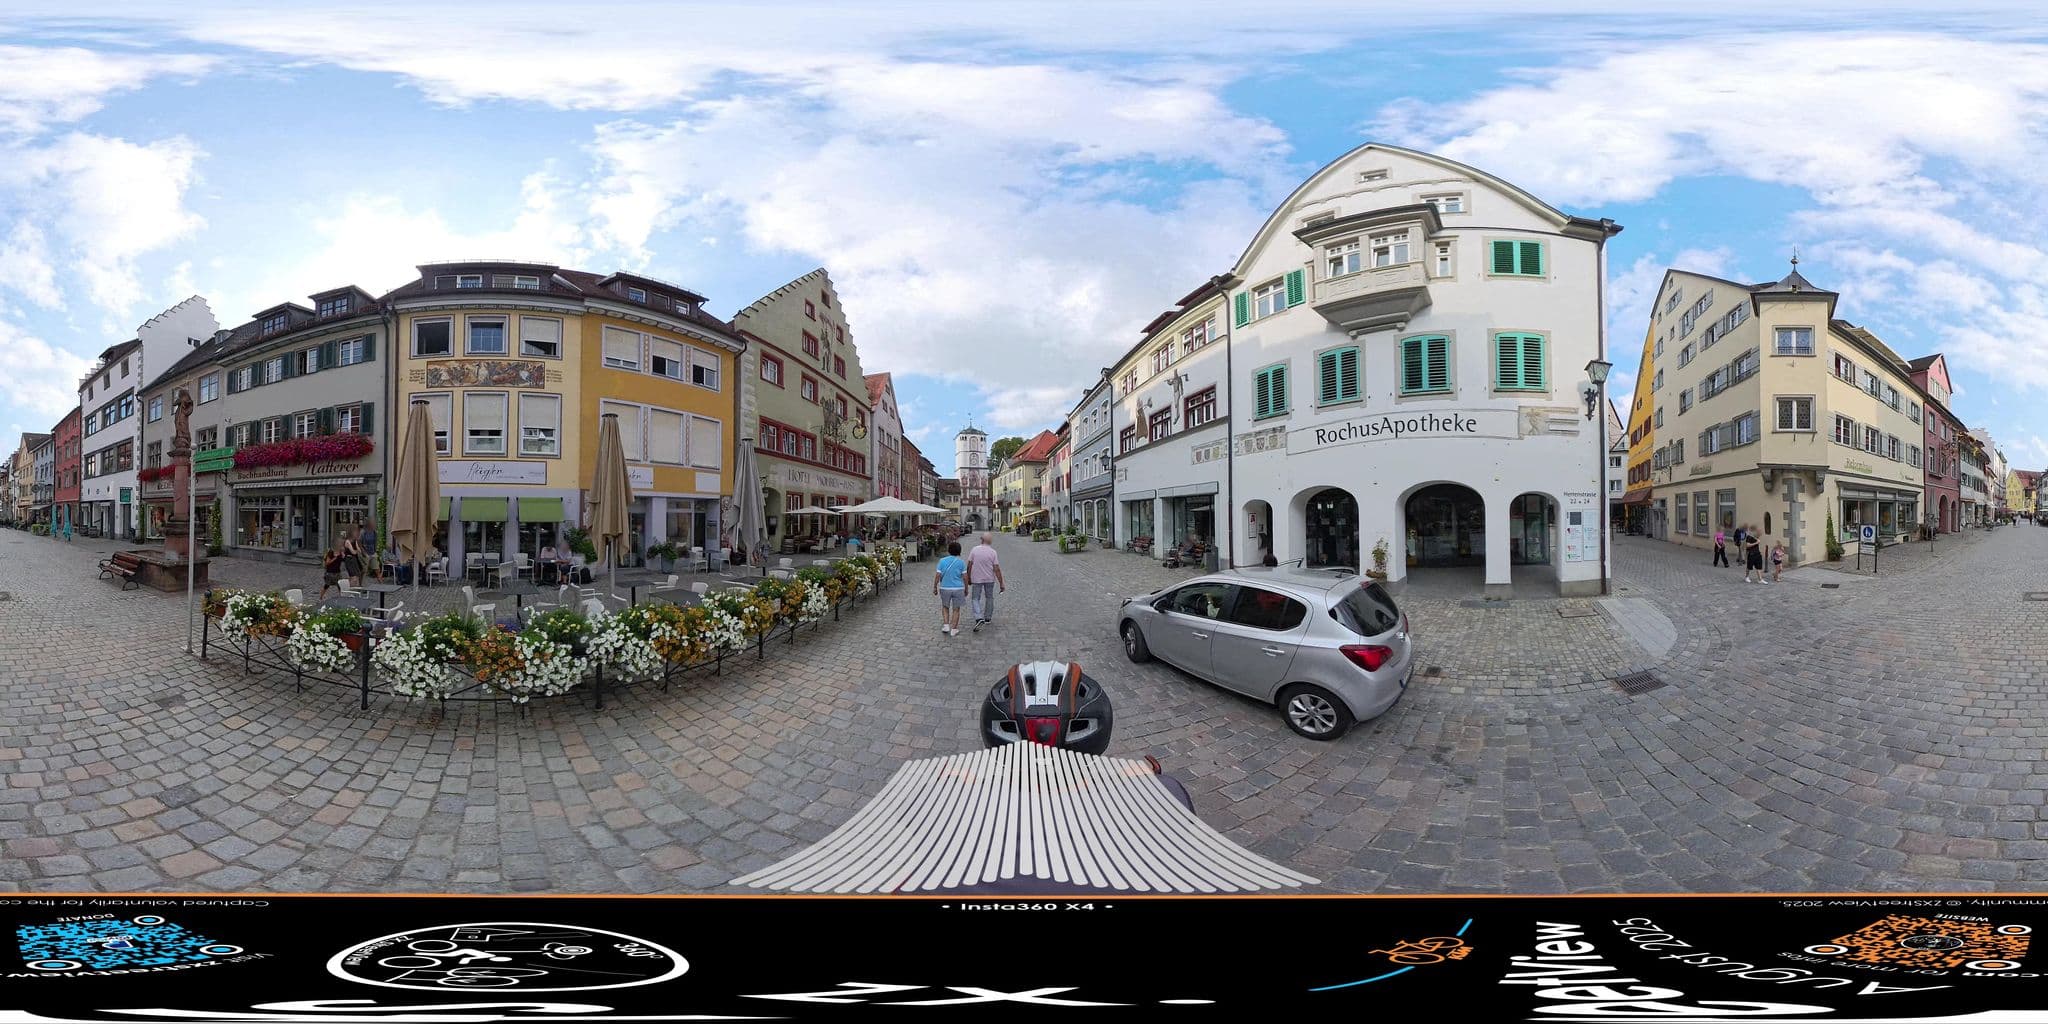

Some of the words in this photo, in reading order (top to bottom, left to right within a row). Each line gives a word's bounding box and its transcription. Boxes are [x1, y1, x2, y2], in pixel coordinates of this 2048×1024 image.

[1315, 412, 1478, 446] RochusApotheke
[237, 468, 289, 480] Buchhandlung
[302, 459, 360, 476] Natterer
